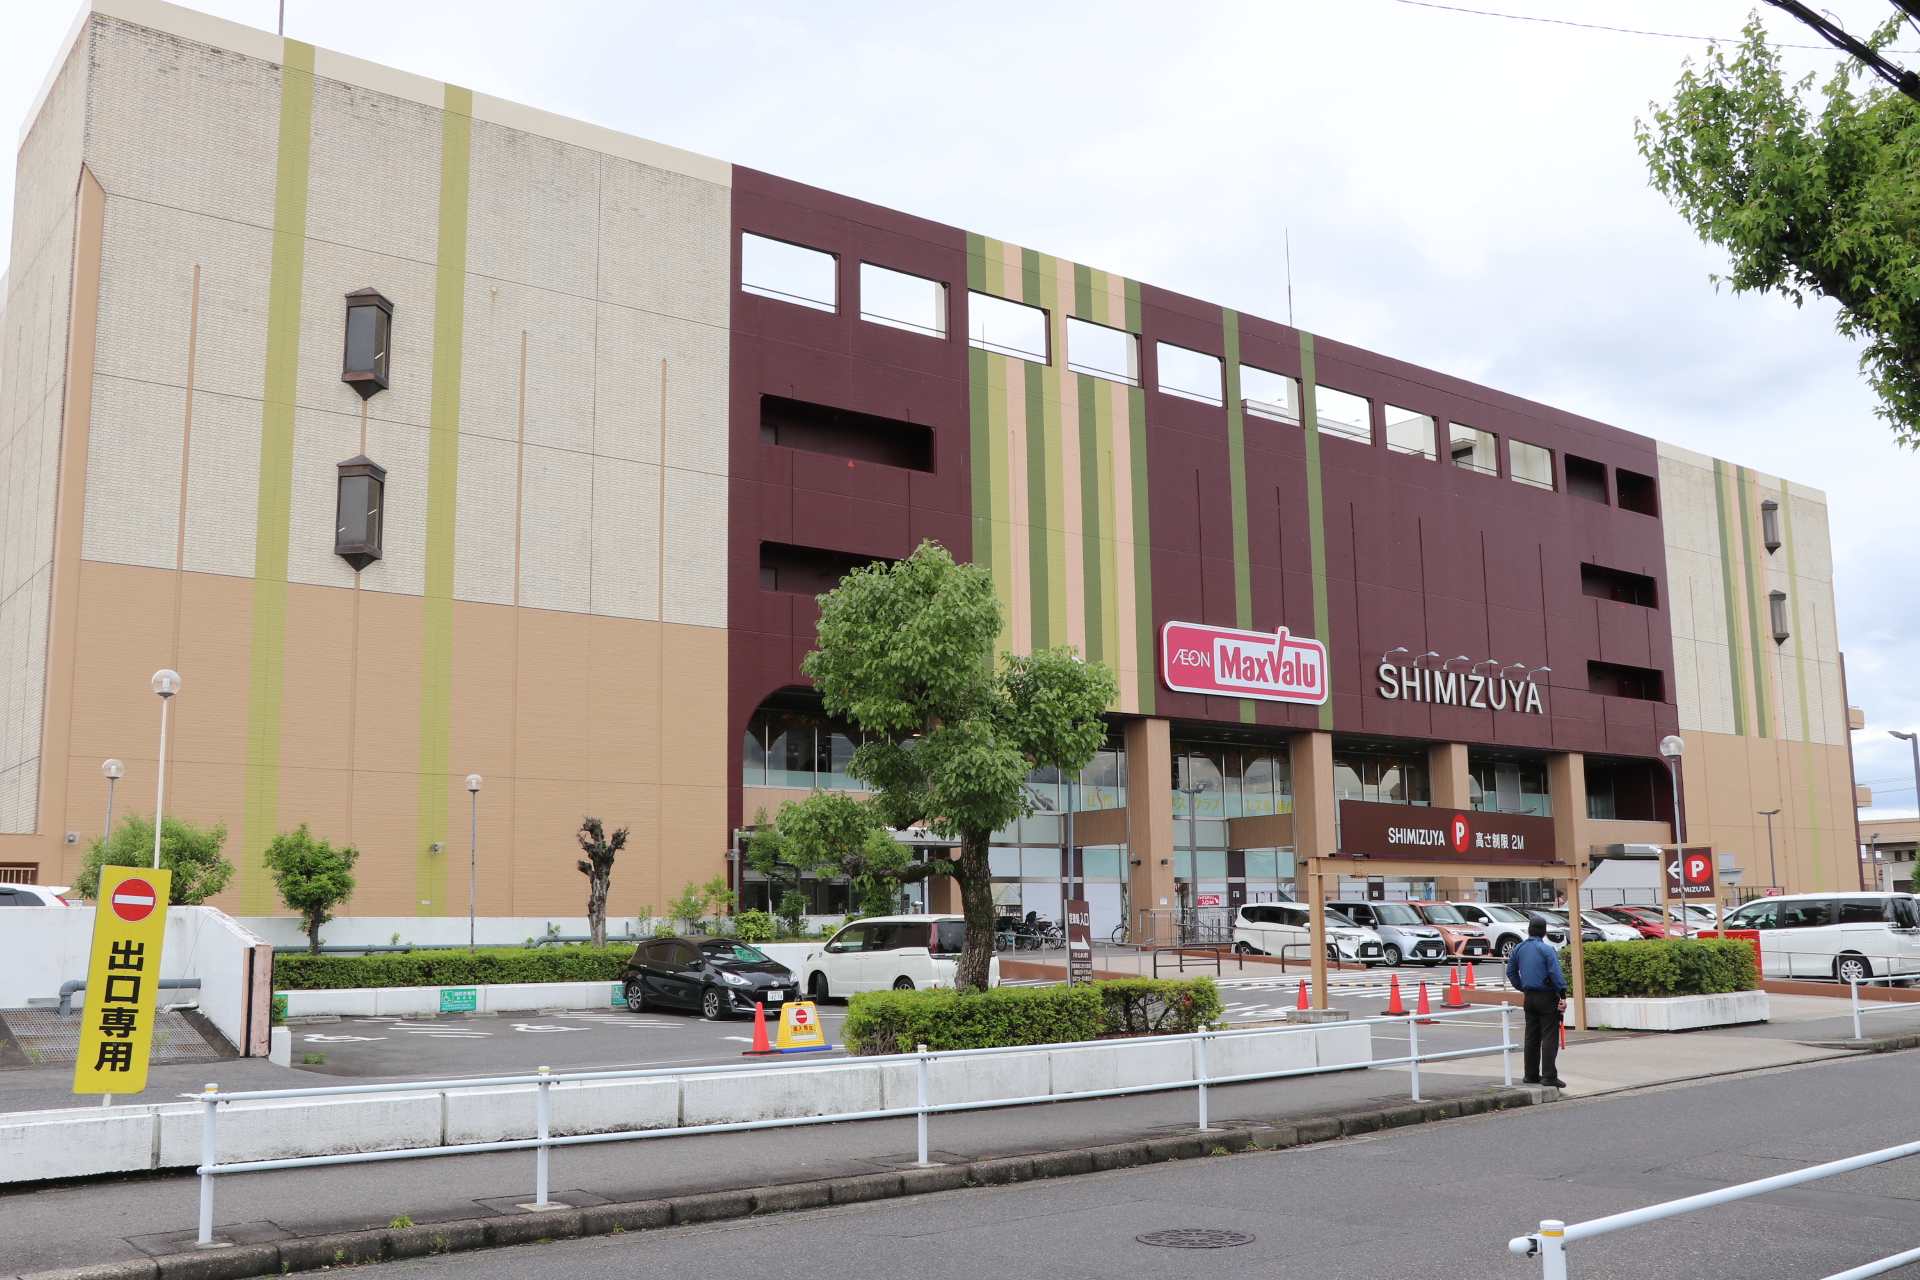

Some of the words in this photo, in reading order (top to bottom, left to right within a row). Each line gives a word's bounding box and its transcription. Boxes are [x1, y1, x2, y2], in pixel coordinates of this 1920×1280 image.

[1219, 631, 1316, 698] MaxValu
[1378, 663, 1543, 715] SHIMIZUYA
[1388, 826, 1446, 846] SHIMIZUYA
[1455, 821, 1465, 846] P
[1475, 831, 1509, 850] 高さ制限
[1511, 834, 1525, 850] 2M
[1690, 860, 1705, 878] P
[1670, 885, 1711, 894] SHMIZUYA
[94, 940, 145, 1072] 出口専用
